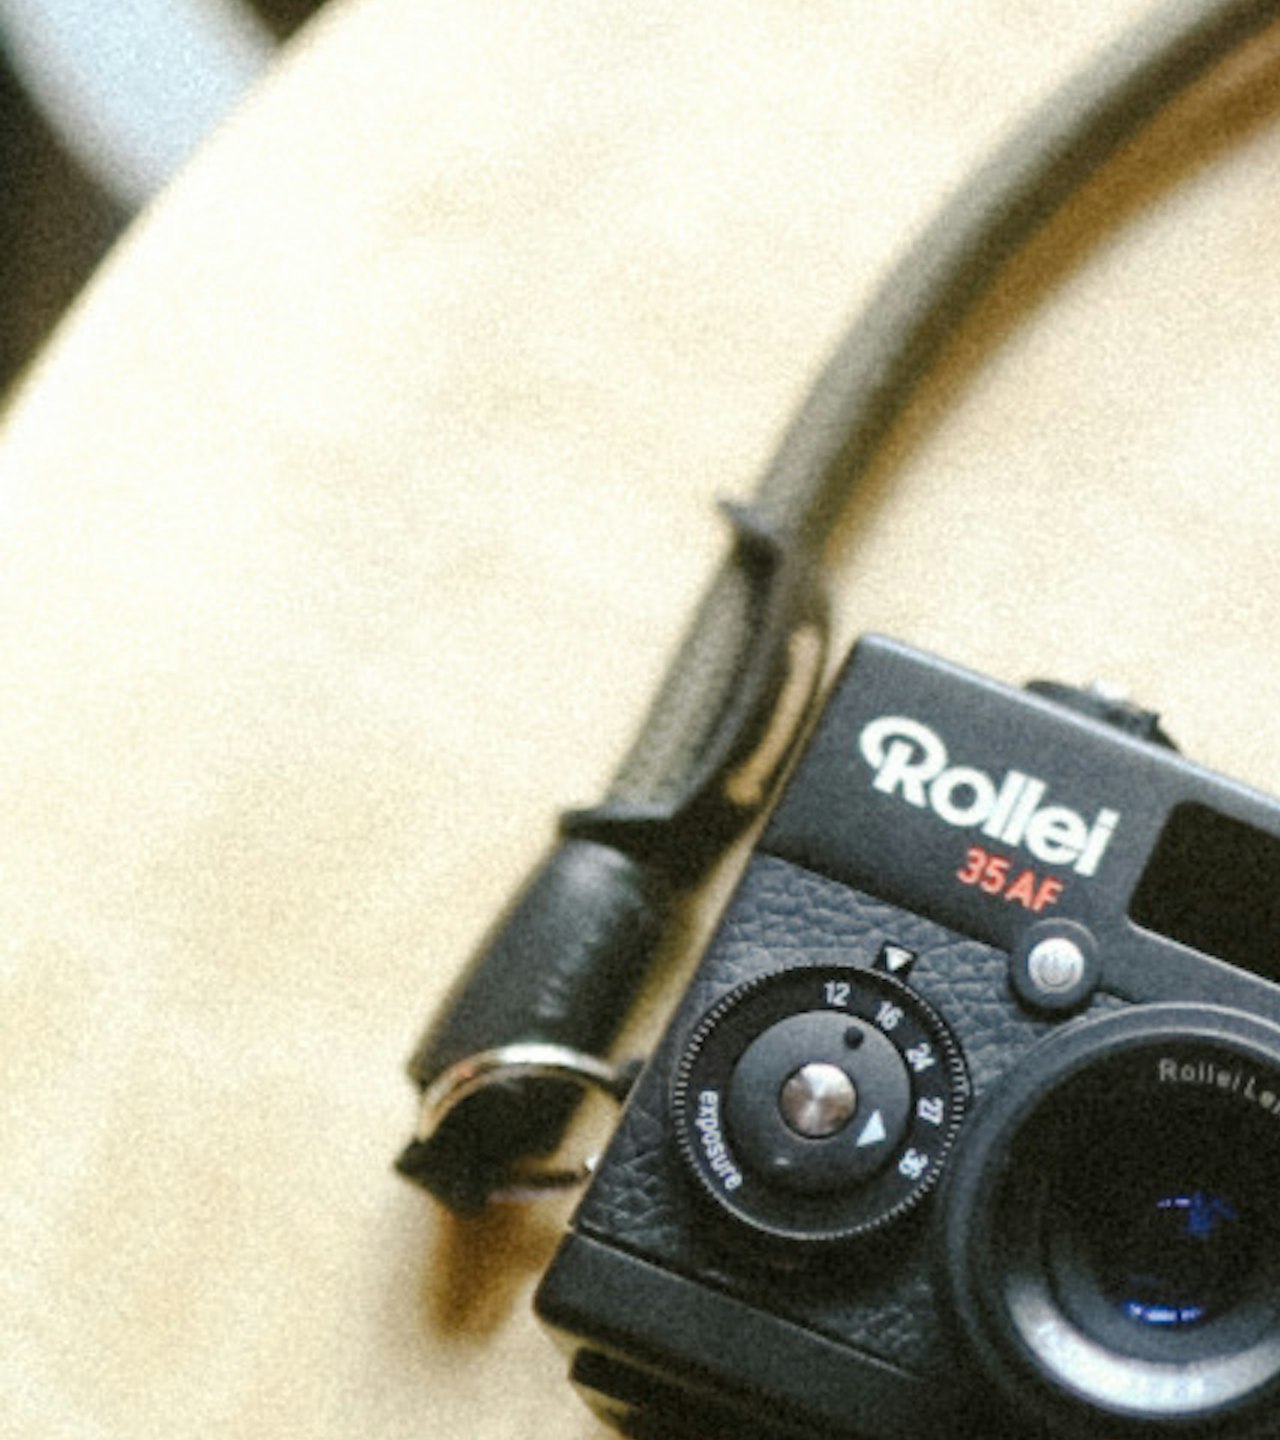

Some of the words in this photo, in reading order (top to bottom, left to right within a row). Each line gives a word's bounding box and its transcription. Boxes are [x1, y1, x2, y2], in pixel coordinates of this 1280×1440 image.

[859, 715, 1121, 878] Rollei
[824, 980, 851, 1007] 12
[876, 1000, 904, 1031] 16
[906, 1042, 935, 1072] 24
[917, 1096, 944, 1125] 27
[695, 1090, 743, 1190] exposure
[899, 1148, 929, 1180] 36
